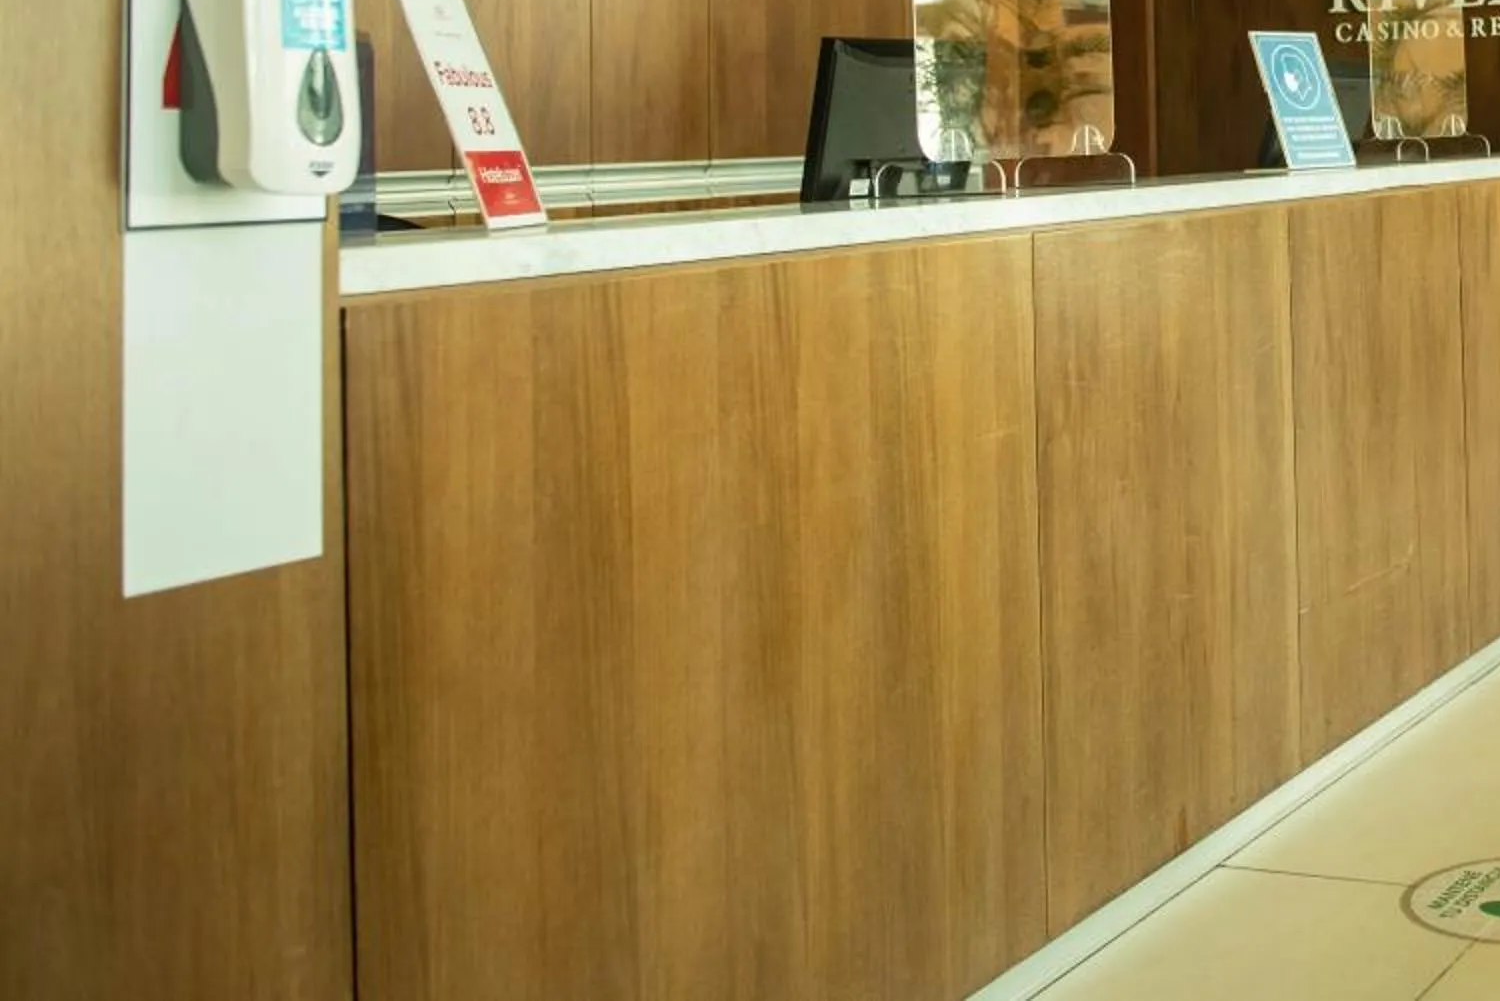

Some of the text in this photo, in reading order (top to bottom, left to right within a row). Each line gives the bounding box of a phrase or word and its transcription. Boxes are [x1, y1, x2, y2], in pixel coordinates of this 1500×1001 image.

[1335, 19, 1440, 44] CASINO
[1445, 20, 1464, 39] &
[434, 61, 493, 88] Fabulous
